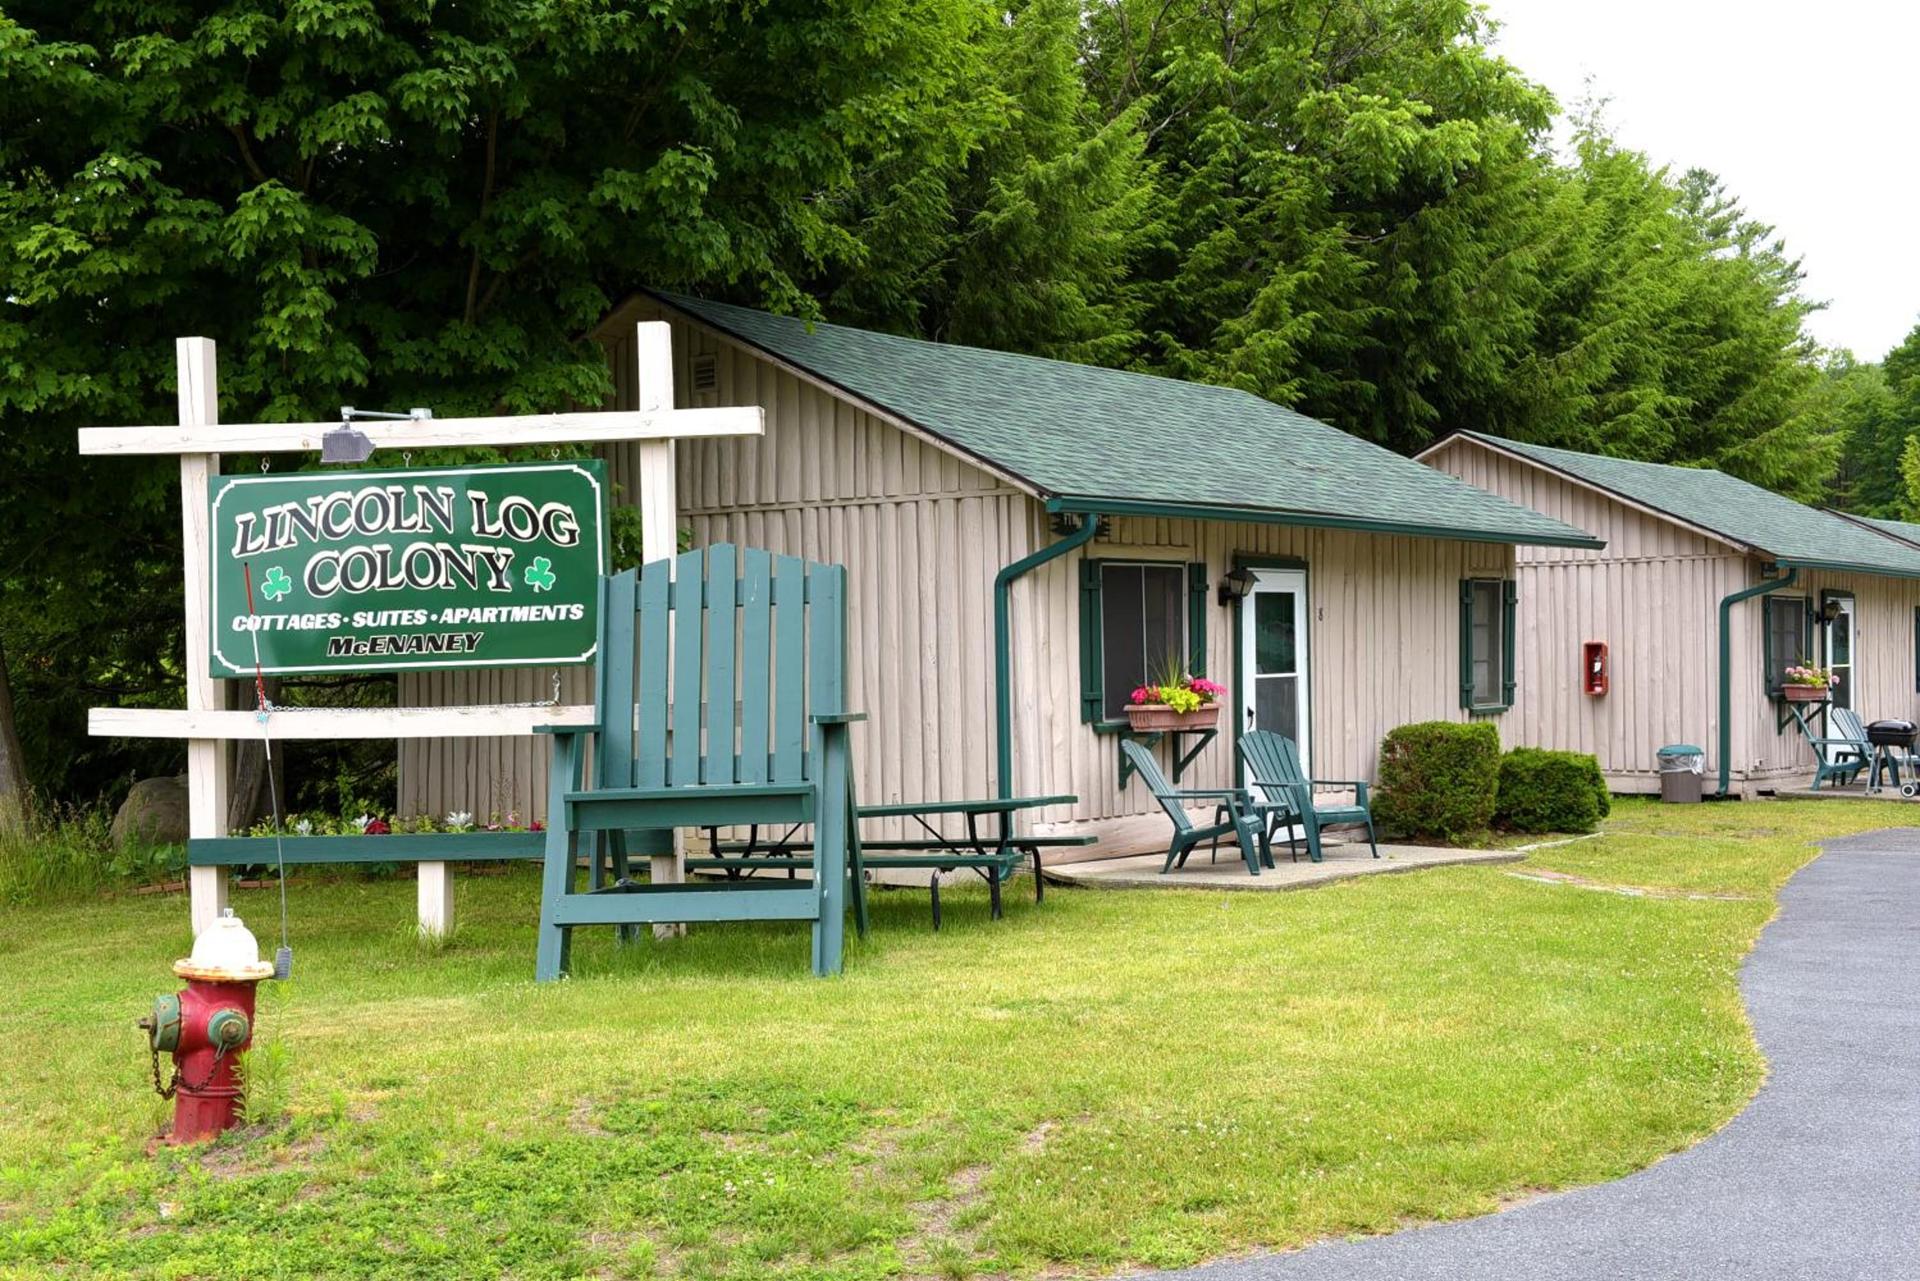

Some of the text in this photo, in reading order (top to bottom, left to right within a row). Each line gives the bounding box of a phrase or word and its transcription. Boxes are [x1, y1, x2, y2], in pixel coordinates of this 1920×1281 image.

[231, 485, 581, 558] LINCOLN LOG
[304, 541, 515, 598] COLONY
[232, 603, 584, 632] COTTAGES SUITES APARTMENTS
[326, 631, 485, 657] McENANEY
